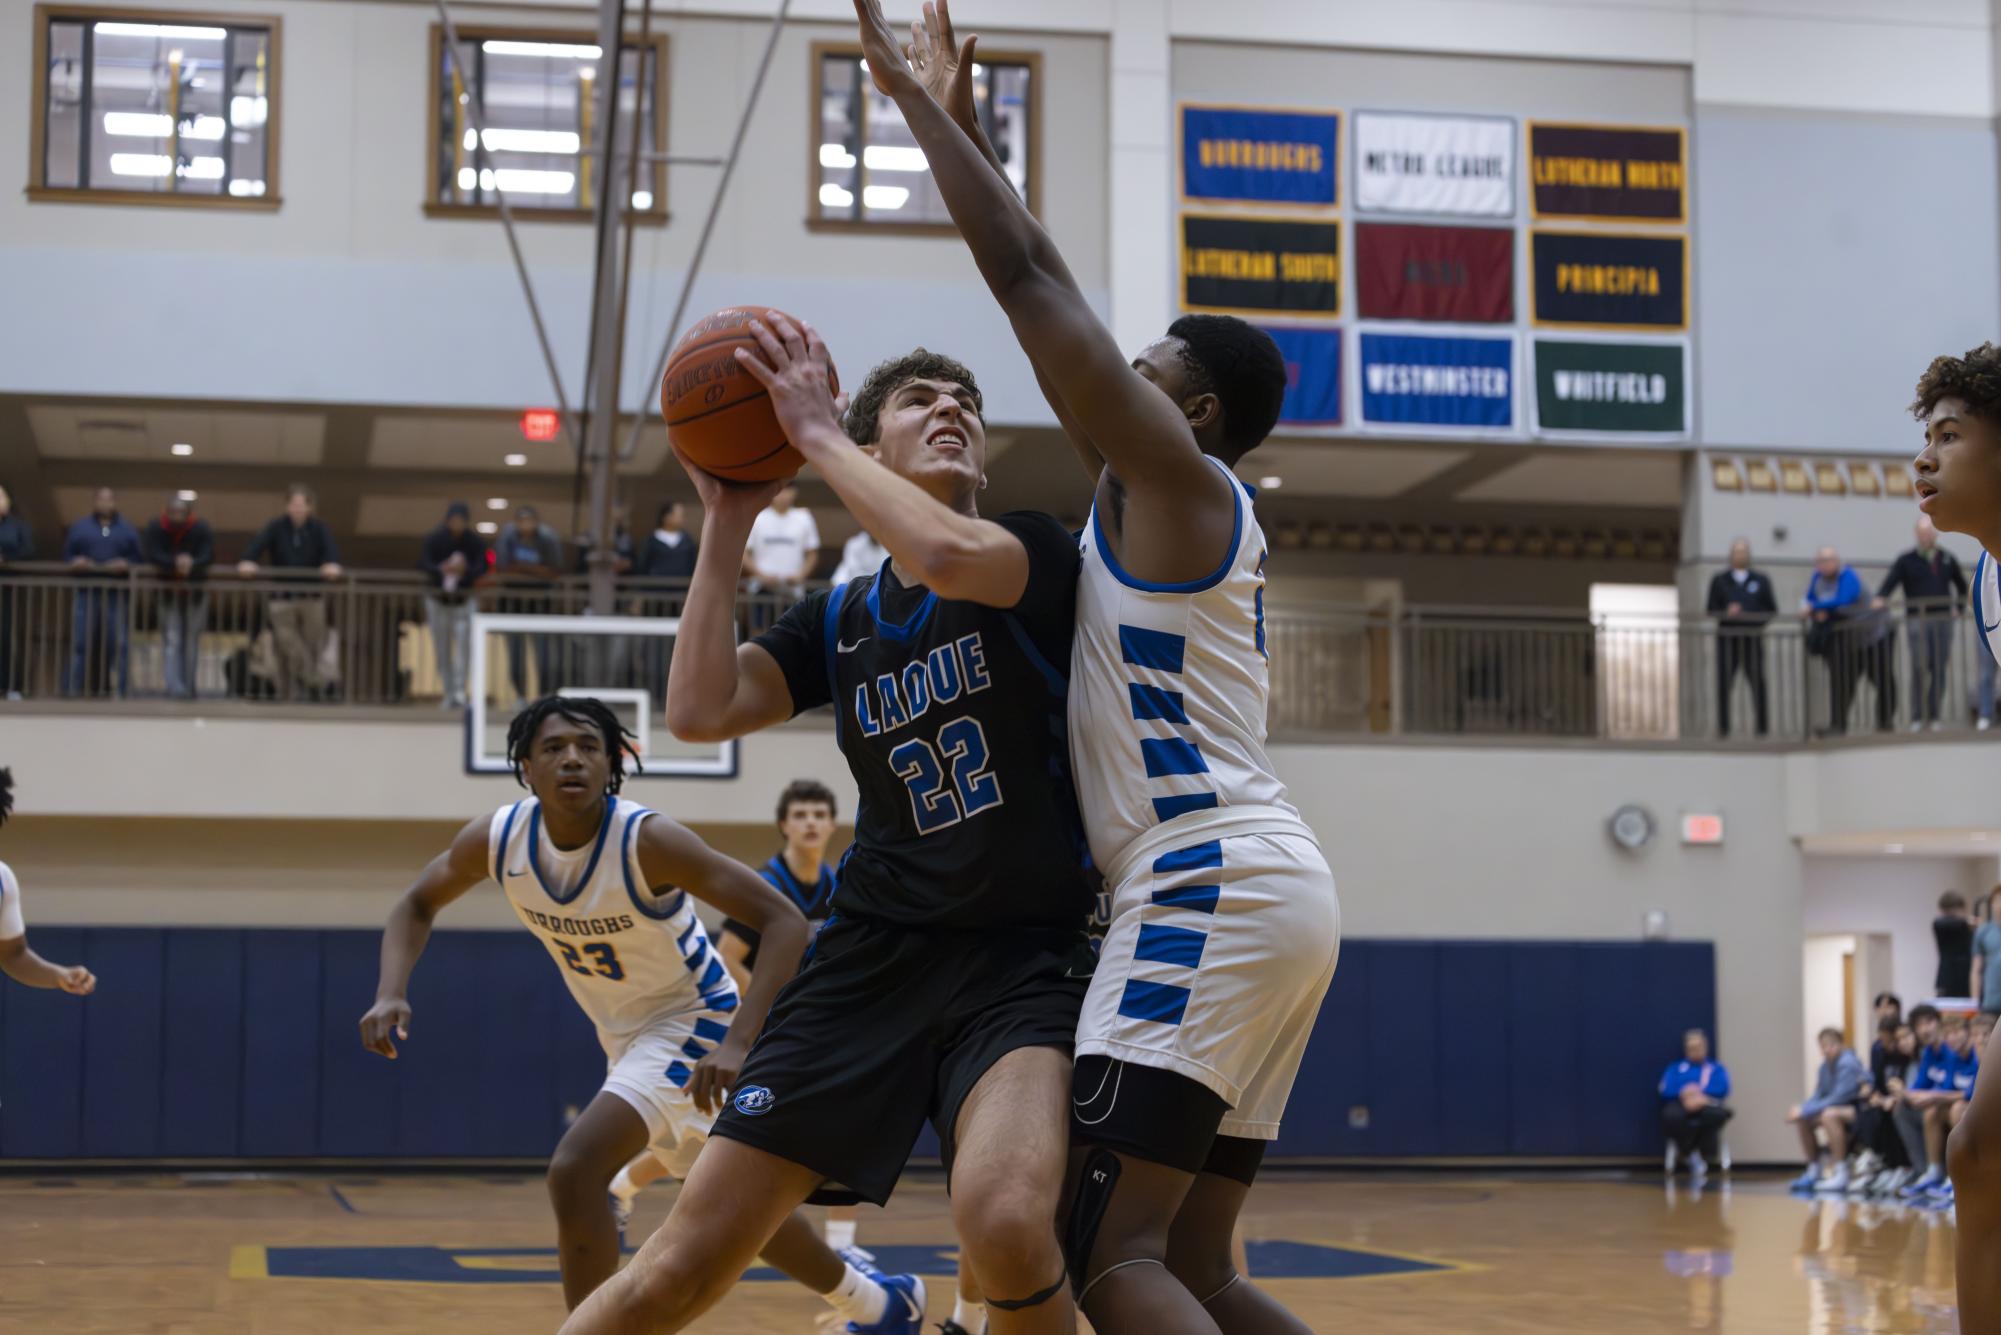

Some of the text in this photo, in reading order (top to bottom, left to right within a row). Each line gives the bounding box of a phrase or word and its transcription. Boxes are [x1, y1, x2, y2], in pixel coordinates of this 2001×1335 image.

[1366, 152, 1503, 179] METRO LEAGUE
[1534, 157, 1622, 187] LUTHERAN
[1556, 263, 1660, 296] PRINCIPIA
[1367, 363, 1509, 398] WESTMINSTER
[1553, 369, 1666, 404] WHITFIELD
[855, 631, 992, 738] LADUE
[887, 715, 1005, 836] 22
[521, 906, 635, 936] URROUGHS
[551, 937, 627, 982] 23
[1092, 1169, 1107, 1184] KT
